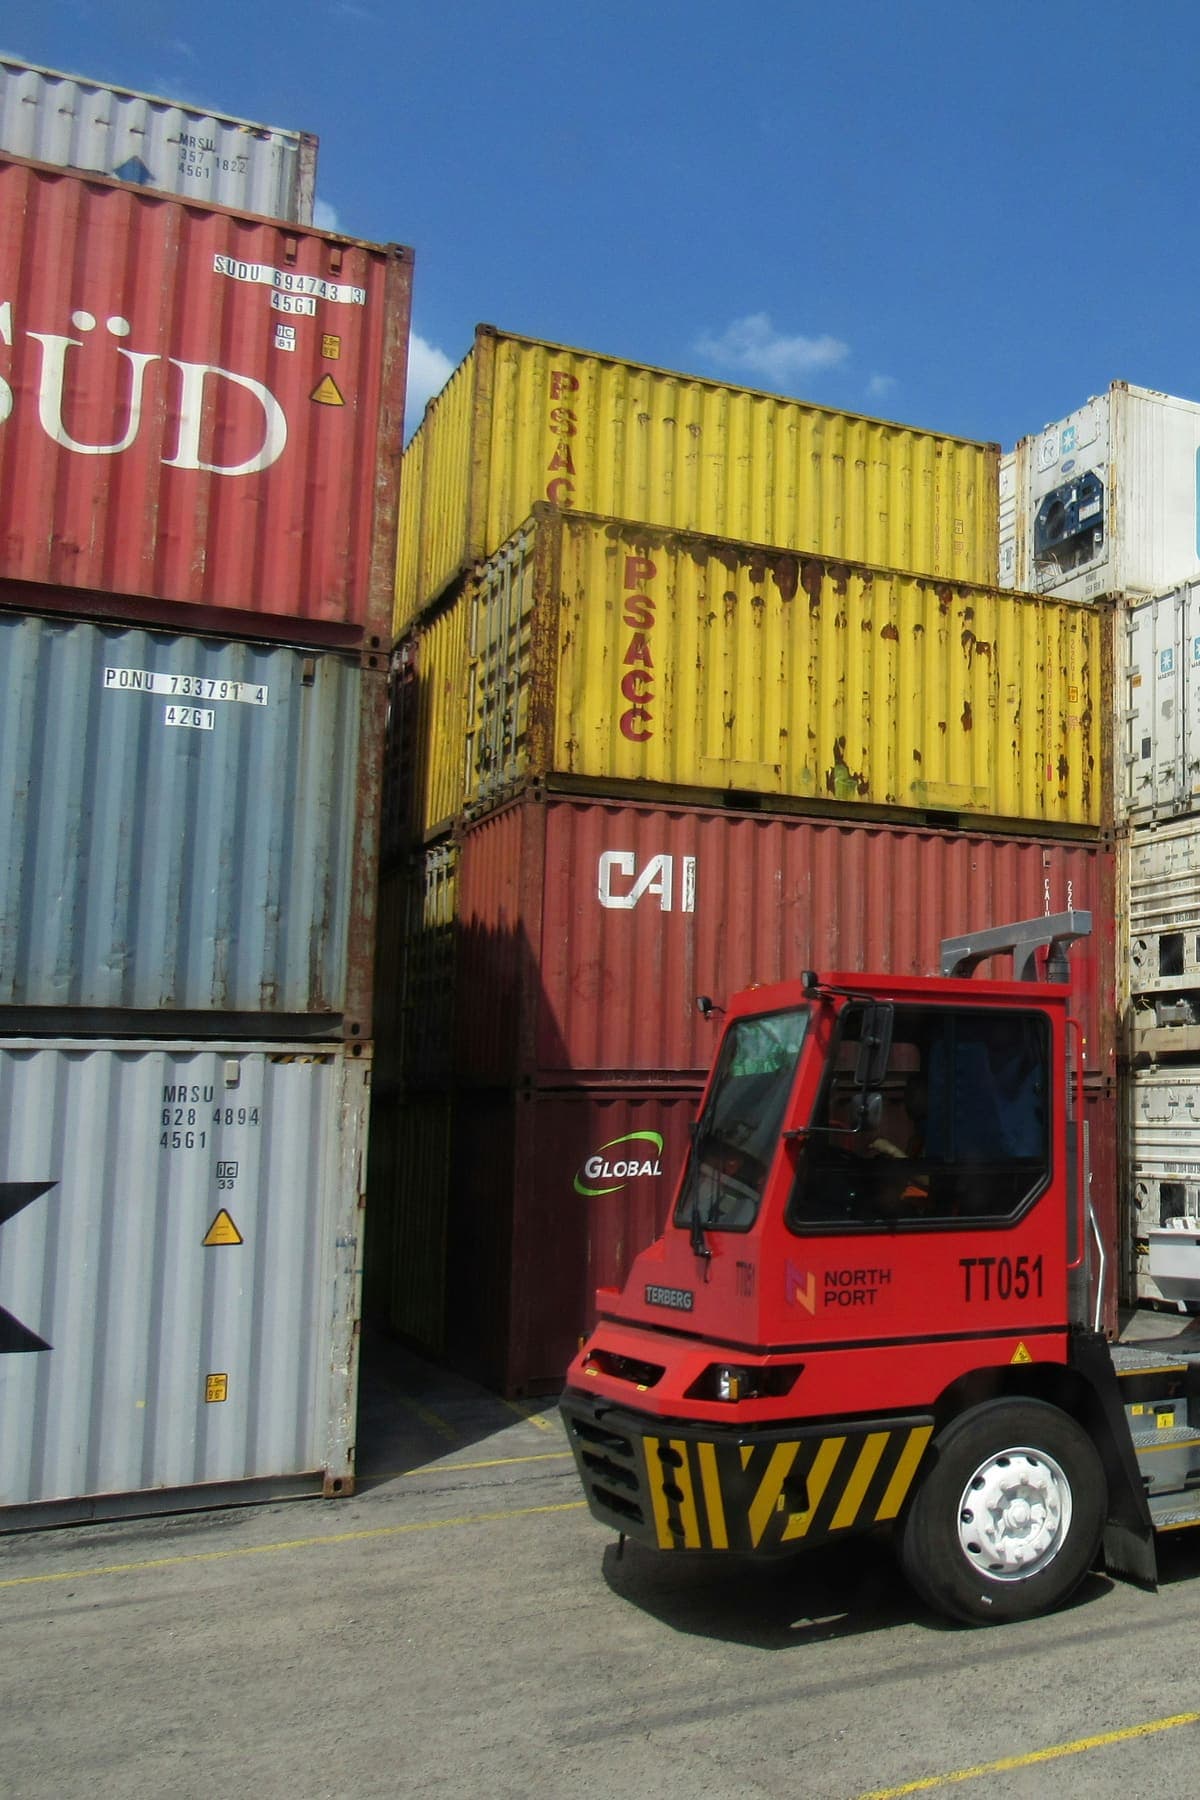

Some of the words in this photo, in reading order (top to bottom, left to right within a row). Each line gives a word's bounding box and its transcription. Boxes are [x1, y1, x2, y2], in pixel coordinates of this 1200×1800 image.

[180, 133, 213, 148] MRSU
[181, 149, 205, 163] 357
[179, 162, 209, 178] 45G1
[215, 256, 259, 281] SUDU
[273, 270, 338, 300] 694743
[353, 288, 361, 303] 3
[272, 293, 314, 314] 45G1
[620, 556, 657, 742] PSACC
[106, 669, 154, 690] PONU
[170, 677, 241, 700] 733791
[256, 687, 264, 703] 4
[167, 707, 213, 728] 42G1
[598, 851, 696, 912] CAI
[163, 1085, 214, 1102] MRSU
[162, 1108, 196, 1126] 628
[212, 1108, 259, 1126] 4894
[160, 1131, 206, 1149] 45G1
[585, 1156, 662, 1178] GLOBAL
[218, 1180, 234, 1190] 33
[824, 1268, 892, 1286] NORTH
[959, 1253, 1044, 1303] TT051
[645, 1285, 692, 1309] TERBERG
[824, 1289, 878, 1307] PORT
